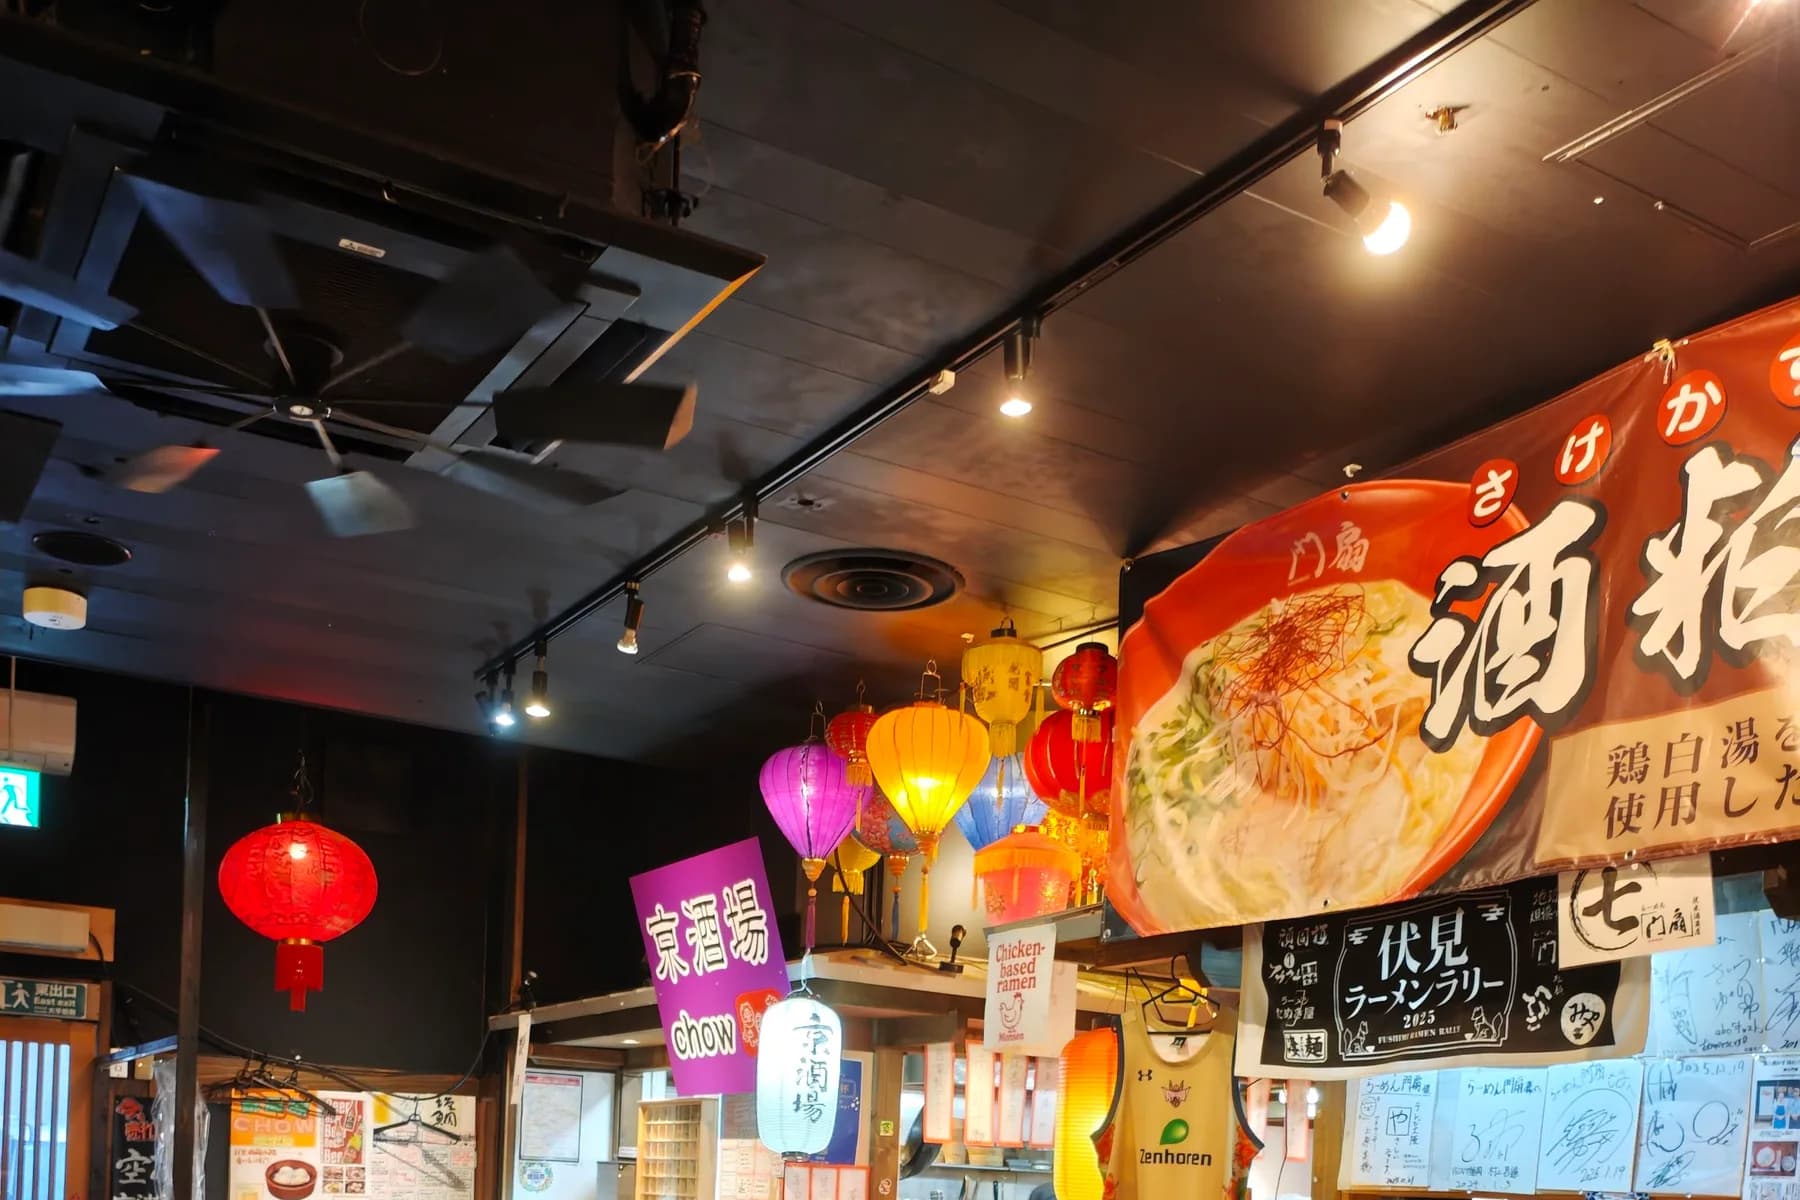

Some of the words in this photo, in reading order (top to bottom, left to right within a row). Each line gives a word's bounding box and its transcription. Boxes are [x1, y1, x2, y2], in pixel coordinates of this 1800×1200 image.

[645, 878, 769, 984] 京酒場
[996, 940, 1046, 962] Chicken-
[1377, 906, 1469, 981] 伏見
[1000, 957, 1036, 978] based
[34, 983, 77, 998] 東出口
[996, 975, 1037, 993] ramen
[1345, 966, 1504, 1020] ラーメンラリー
[34, 997, 56, 1006] East
[57, 999, 76, 1008] exit
[1403, 1009, 1435, 1029] 2025
[671, 1009, 737, 1059] chow
[792, 1012, 835, 1124] 京酒場
[1140, 1148, 1212, 1166] Zenhoren
